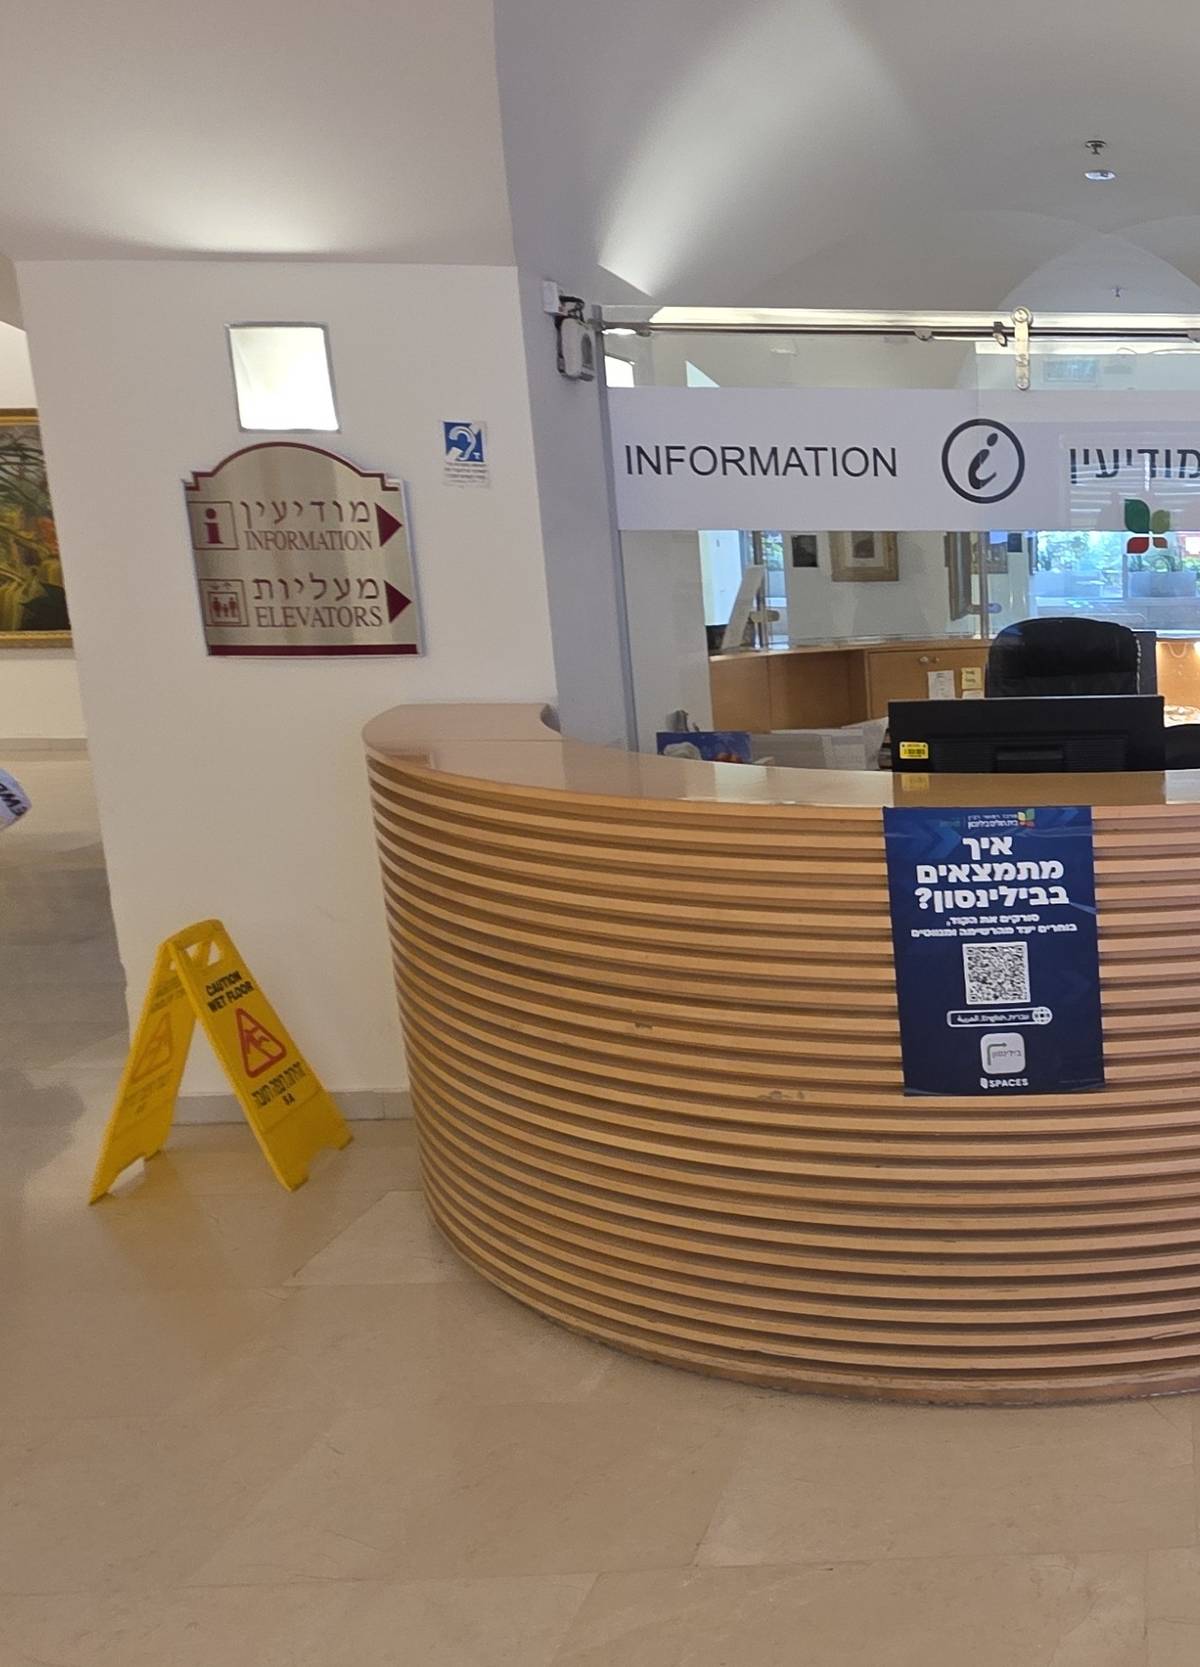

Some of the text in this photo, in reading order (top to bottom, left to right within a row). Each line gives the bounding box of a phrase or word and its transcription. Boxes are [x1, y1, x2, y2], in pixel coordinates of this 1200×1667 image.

[625, 445, 897, 477] INFORMATION
[239, 500, 371, 529] מודיעין
[243, 530, 374, 551] INFORMATION
[252, 572, 381, 601] מעליות
[255, 605, 384, 628] ELEVATORS
[962, 836, 1013, 860] איך
[916, 860, 1065, 883] מתמצאים
[915, 885, 1069, 913] בבילינסון?
[979, 916, 998, 924] את
[206, 970, 242, 996] CAUTION
[208, 995, 226, 1012] WET
[226, 981, 254, 1003] FLOOR
[989, 1078, 1029, 1088] SPACES
